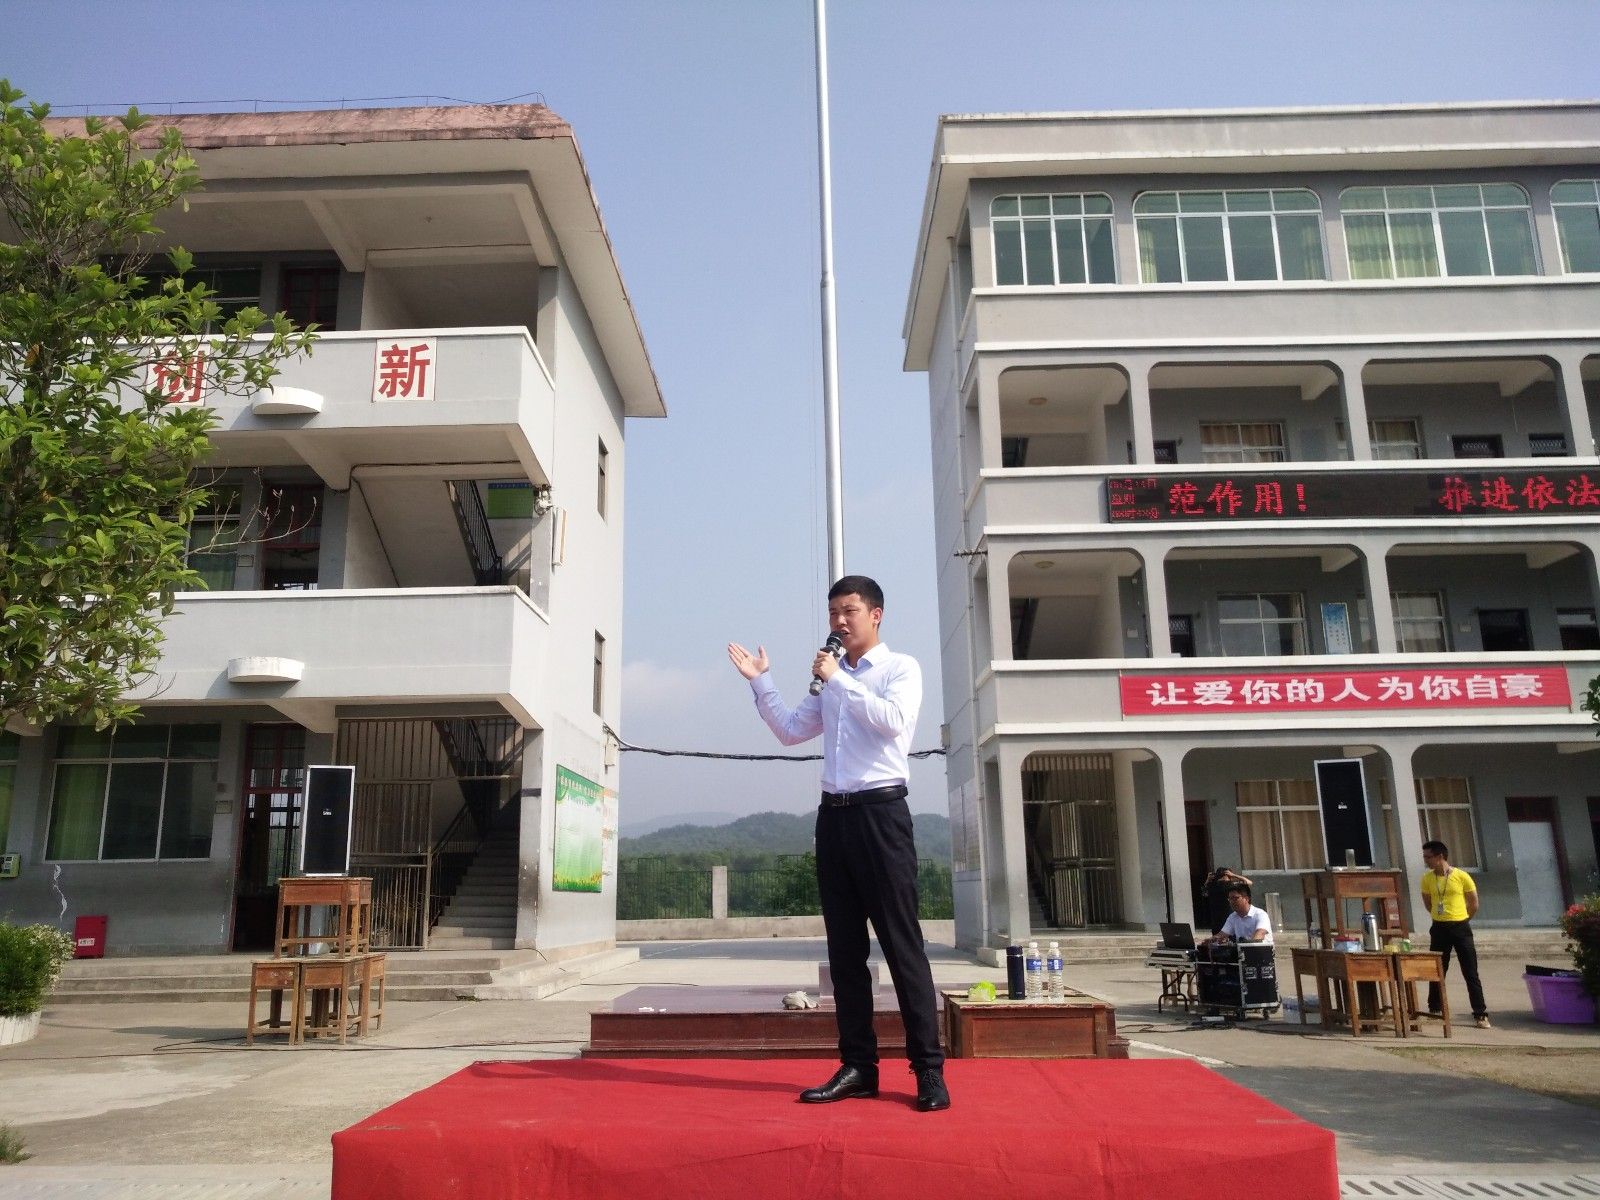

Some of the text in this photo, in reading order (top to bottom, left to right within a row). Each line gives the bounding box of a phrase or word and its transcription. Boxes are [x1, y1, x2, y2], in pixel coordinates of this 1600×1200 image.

[153, 344, 430, 403] 创 新
[1145, 673, 1544, 706] 让爱你的人为你自豪
